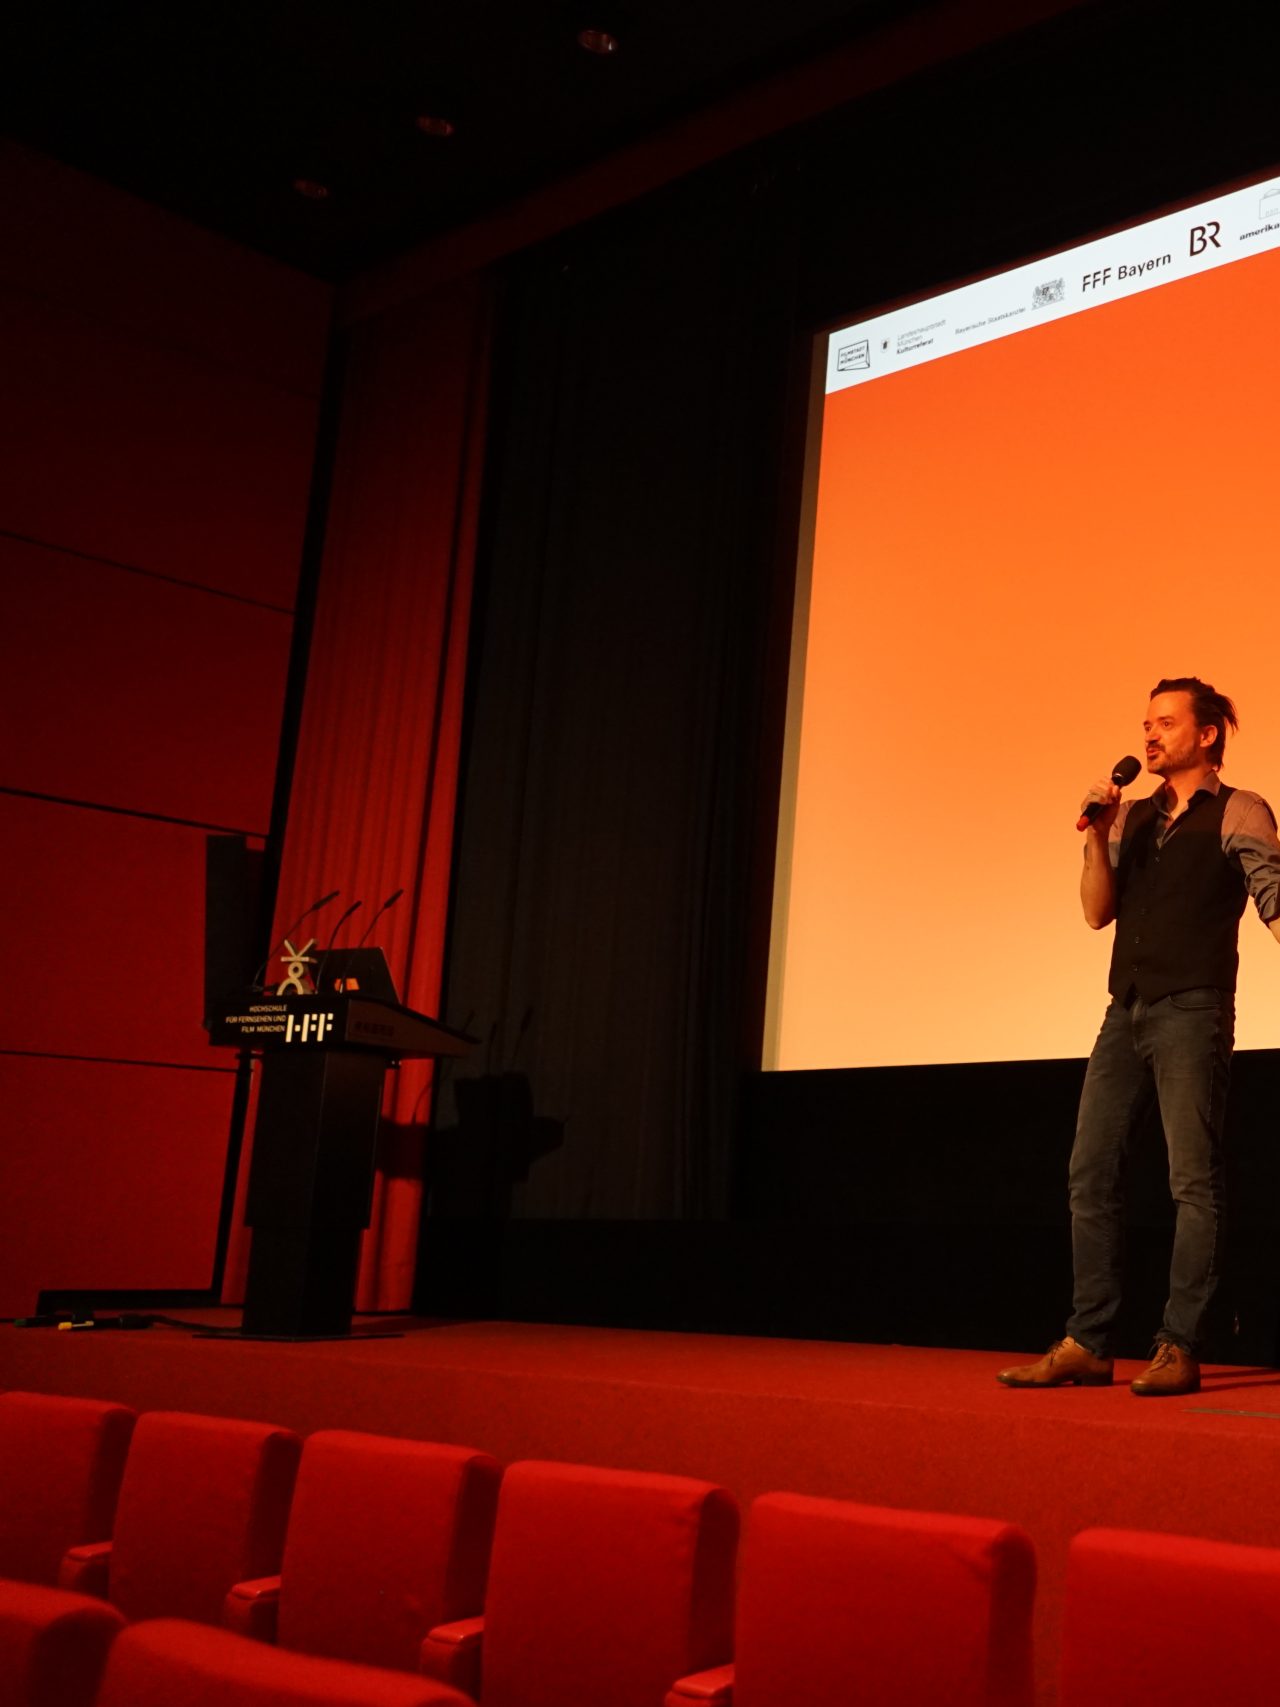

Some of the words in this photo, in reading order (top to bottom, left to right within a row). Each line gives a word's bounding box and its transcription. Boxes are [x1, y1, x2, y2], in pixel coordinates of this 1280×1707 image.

[1189, 221, 1222, 257] BR
[1082, 267, 1112, 293] FFF
[1117, 253, 1172, 280] Bayern
[249, 1004, 288, 1013] HOCHSCHULE
[238, 1015, 273, 1024] FERNSEHEN
[273, 1014, 287, 1023] UND
[241, 1025, 255, 1033] FILM
[256, 1024, 286, 1033] MÜNCHEN
